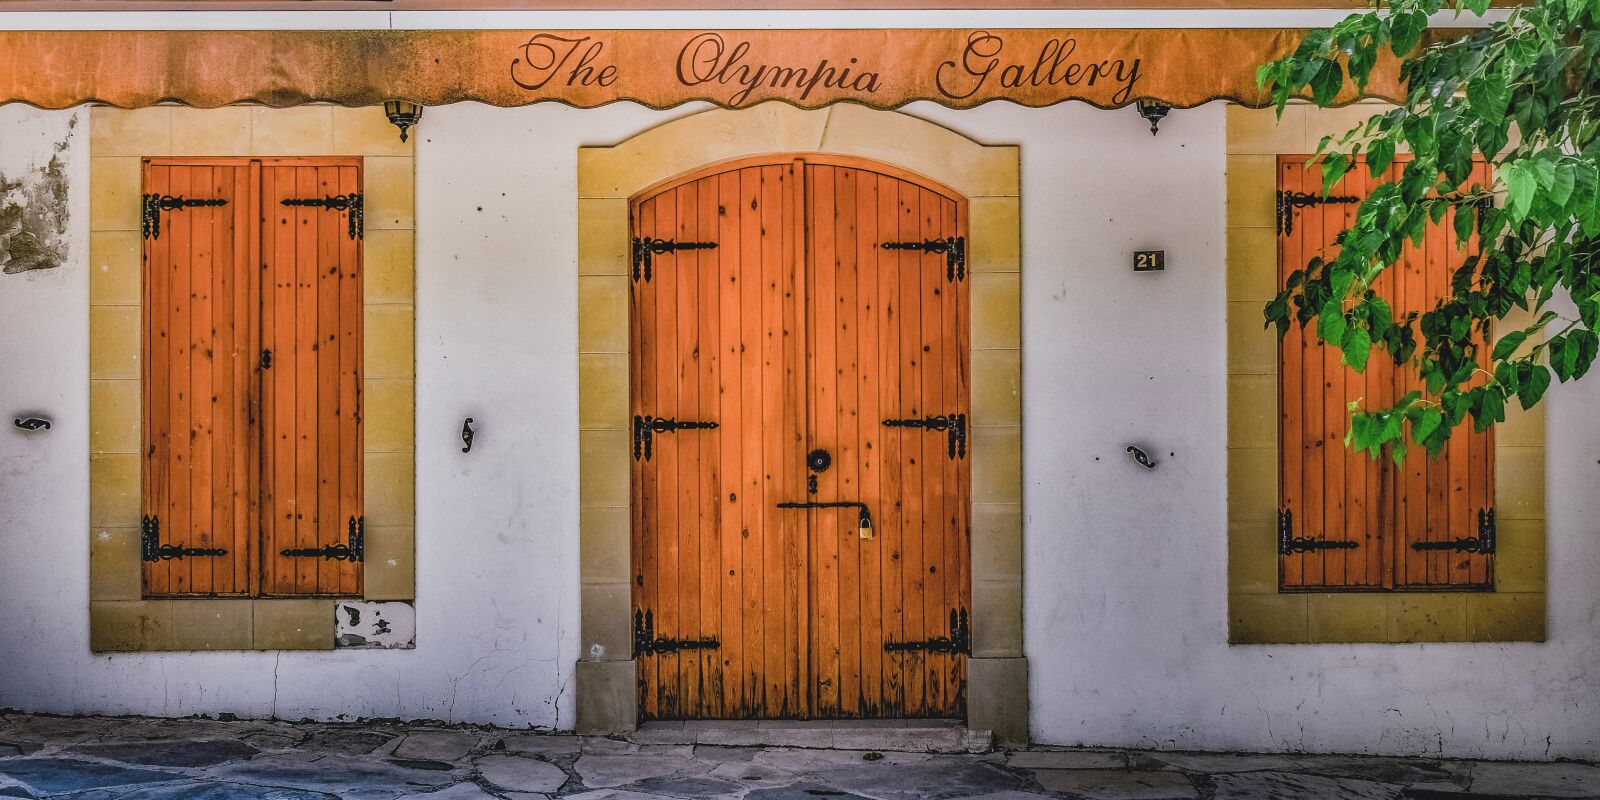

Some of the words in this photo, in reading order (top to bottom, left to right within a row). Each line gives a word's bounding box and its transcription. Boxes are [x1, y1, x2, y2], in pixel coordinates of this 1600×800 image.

[510, 33, 618, 91] The
[676, 32, 882, 107] Olympia
[935, 30, 1142, 105] Gallery
[1137, 254, 1155, 267] 21
